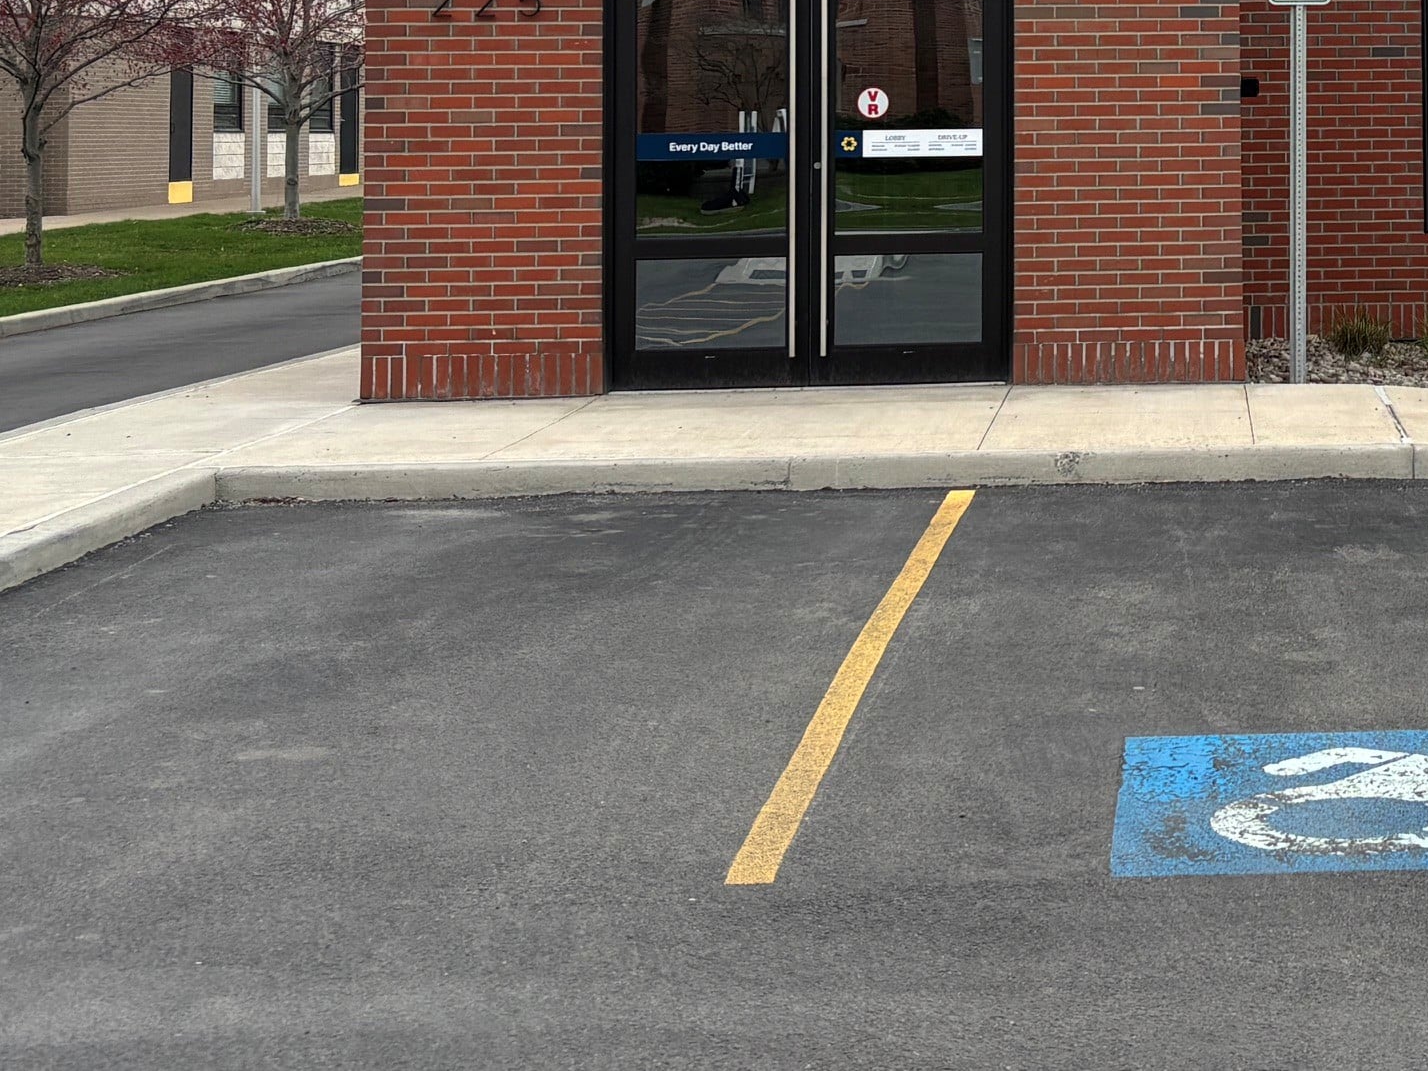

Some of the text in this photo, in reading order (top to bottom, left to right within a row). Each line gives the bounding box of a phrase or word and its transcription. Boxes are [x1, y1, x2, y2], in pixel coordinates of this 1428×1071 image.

[867, 90, 879, 102] V
[867, 103, 879, 115] R
[669, 142, 753, 153] Every Day Better
